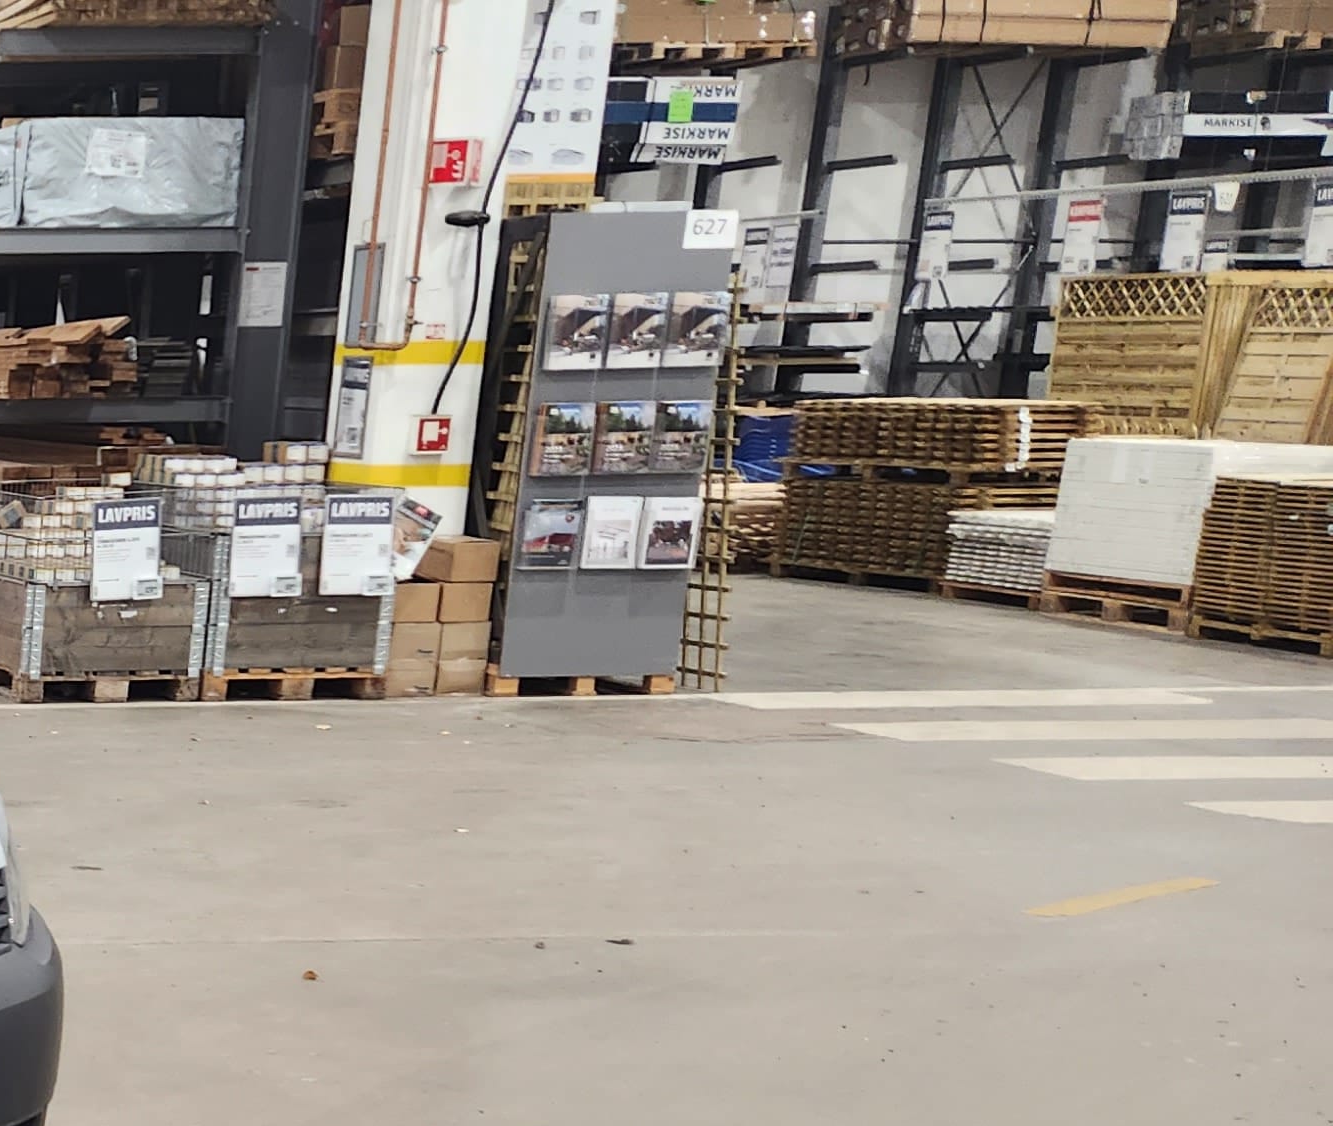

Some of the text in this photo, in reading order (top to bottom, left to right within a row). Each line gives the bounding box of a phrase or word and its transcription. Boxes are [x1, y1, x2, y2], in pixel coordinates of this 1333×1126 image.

[1204, 116, 1252, 129] MARKISE
[663, 127, 731, 140] MARKISE
[654, 145, 722, 160] MARKISE
[692, 218, 728, 236] 627
[97, 504, 156, 524] LAVPRIS
[238, 502, 298, 520] LAVPRIS
[330, 501, 390, 518] LAVPRIS
